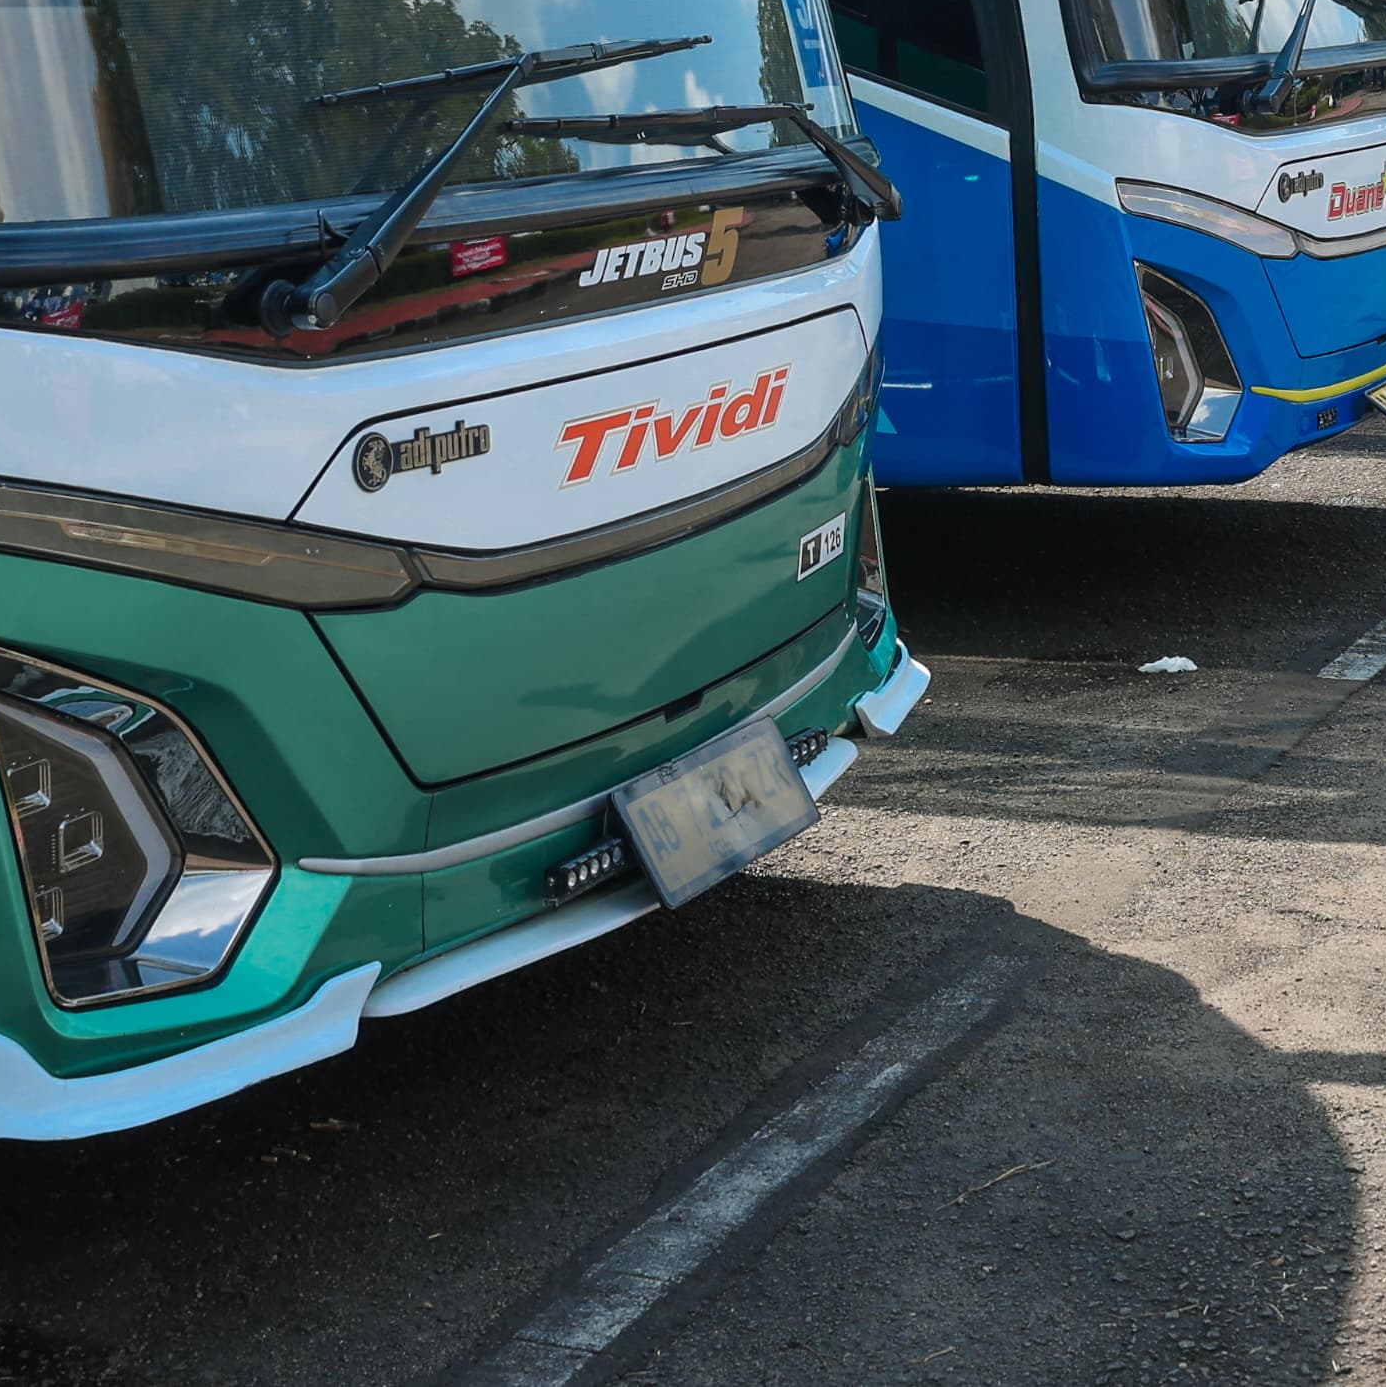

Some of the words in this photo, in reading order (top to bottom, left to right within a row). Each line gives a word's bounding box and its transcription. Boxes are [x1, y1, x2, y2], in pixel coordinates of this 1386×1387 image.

[1327, 182, 1385, 222] Duane
[578, 232, 707, 287] JETBUS
[701, 206, 744, 286] 5
[661, 270, 699, 290] SHD
[398, 420, 491, 474] adiputro
[556, 364, 791, 487] Tividi
[806, 540, 815, 565] T
[824, 526, 841, 555] 126
